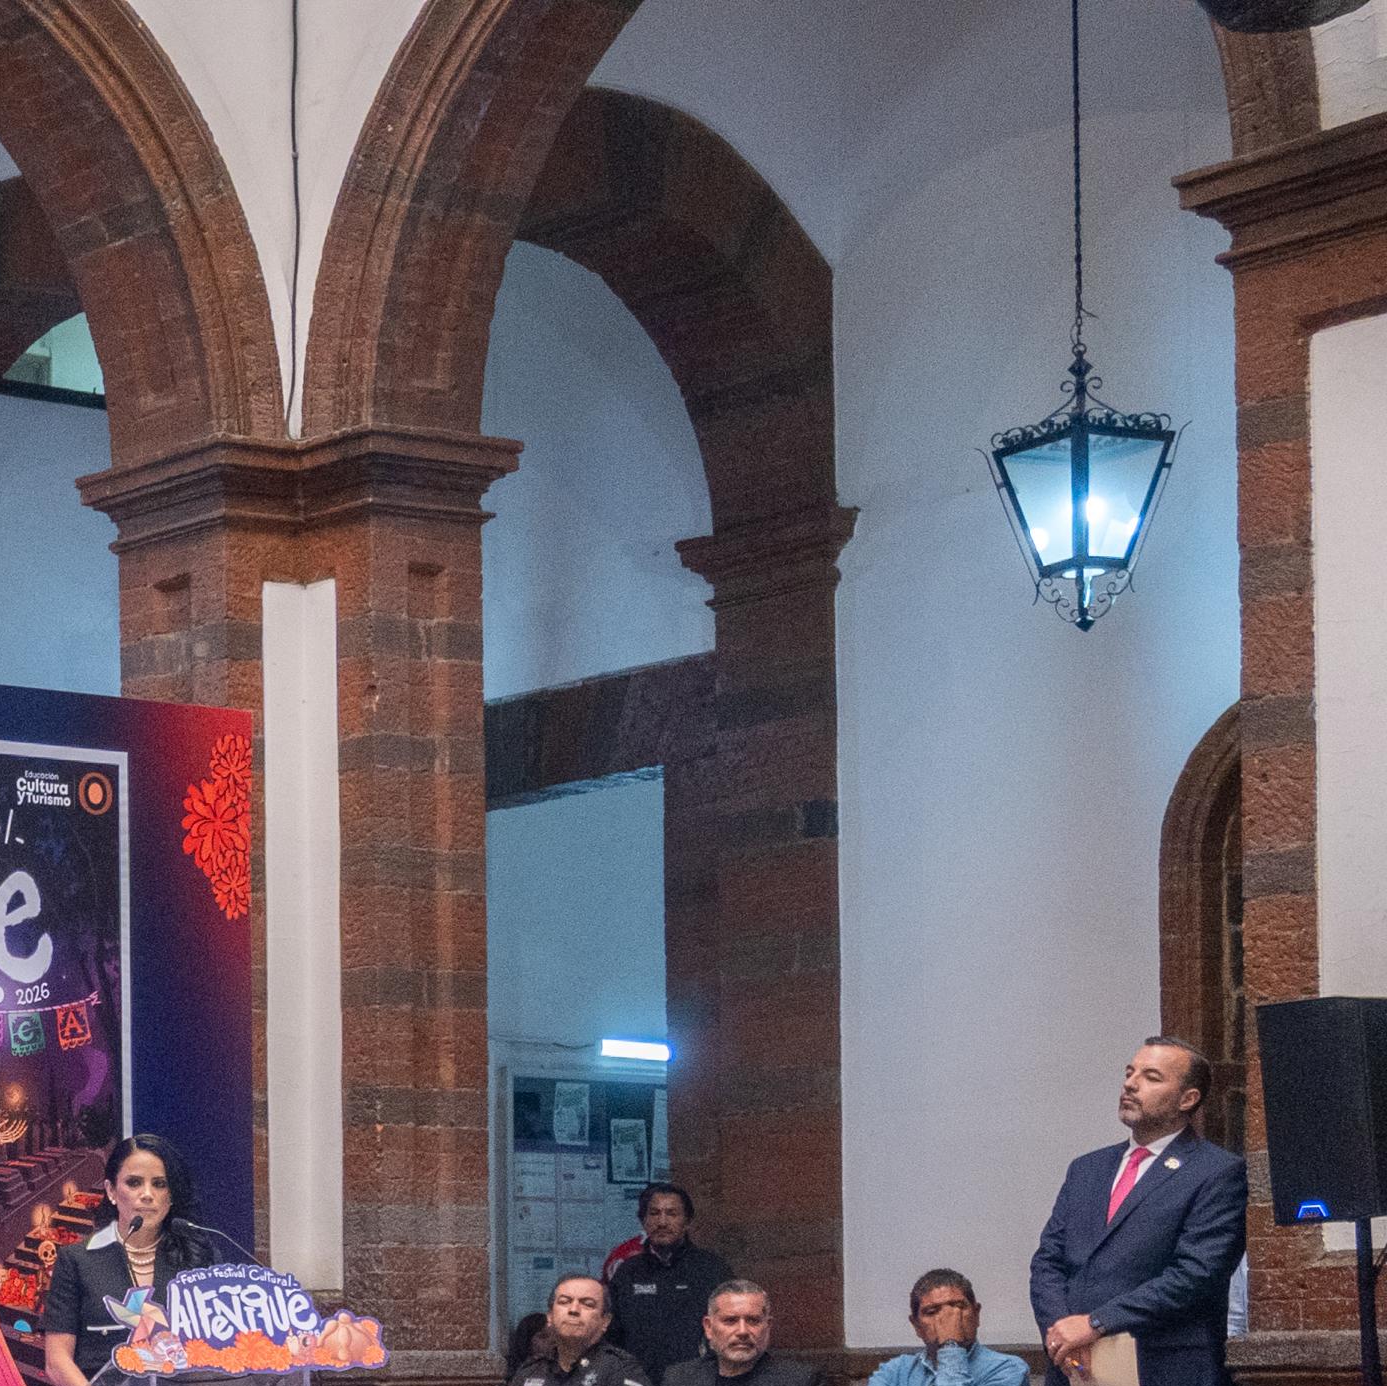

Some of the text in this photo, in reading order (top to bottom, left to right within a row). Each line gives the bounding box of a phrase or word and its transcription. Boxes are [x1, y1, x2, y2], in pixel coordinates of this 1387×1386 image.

[24, 769, 59, 781] Educación
[16, 777, 69, 795] Cultura
[14, 982, 50, 1006] 2026
[213, 1267, 246, 1280] Festival
